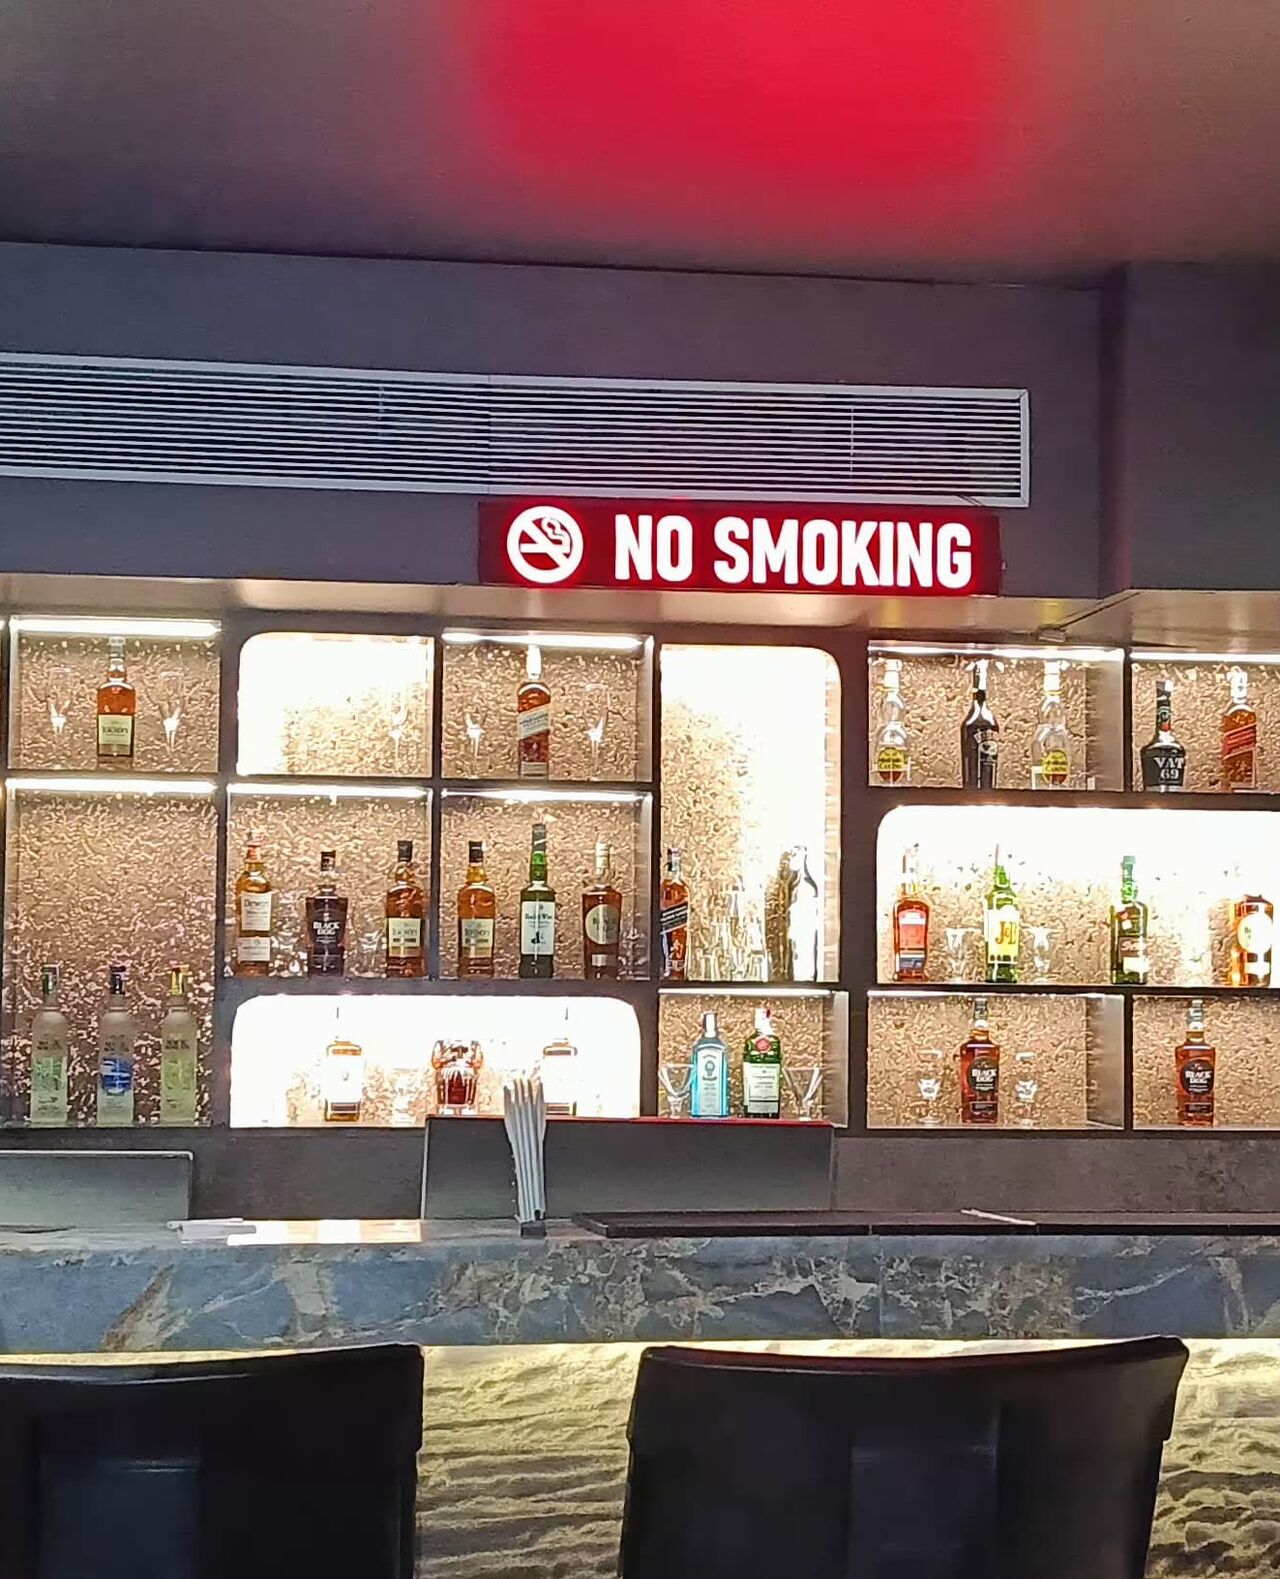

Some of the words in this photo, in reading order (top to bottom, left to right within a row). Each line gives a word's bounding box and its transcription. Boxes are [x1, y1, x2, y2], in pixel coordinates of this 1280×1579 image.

[615, 514, 693, 582] NO
[714, 516, 972, 589] SMOKING
[1154, 757, 1184, 769] VAT
[1160, 769, 1179, 779] 69
[313, 921, 340, 929] BLACK
[972, 1068, 997, 1077] BLACK
[1185, 1070, 1212, 1078] BLACK
